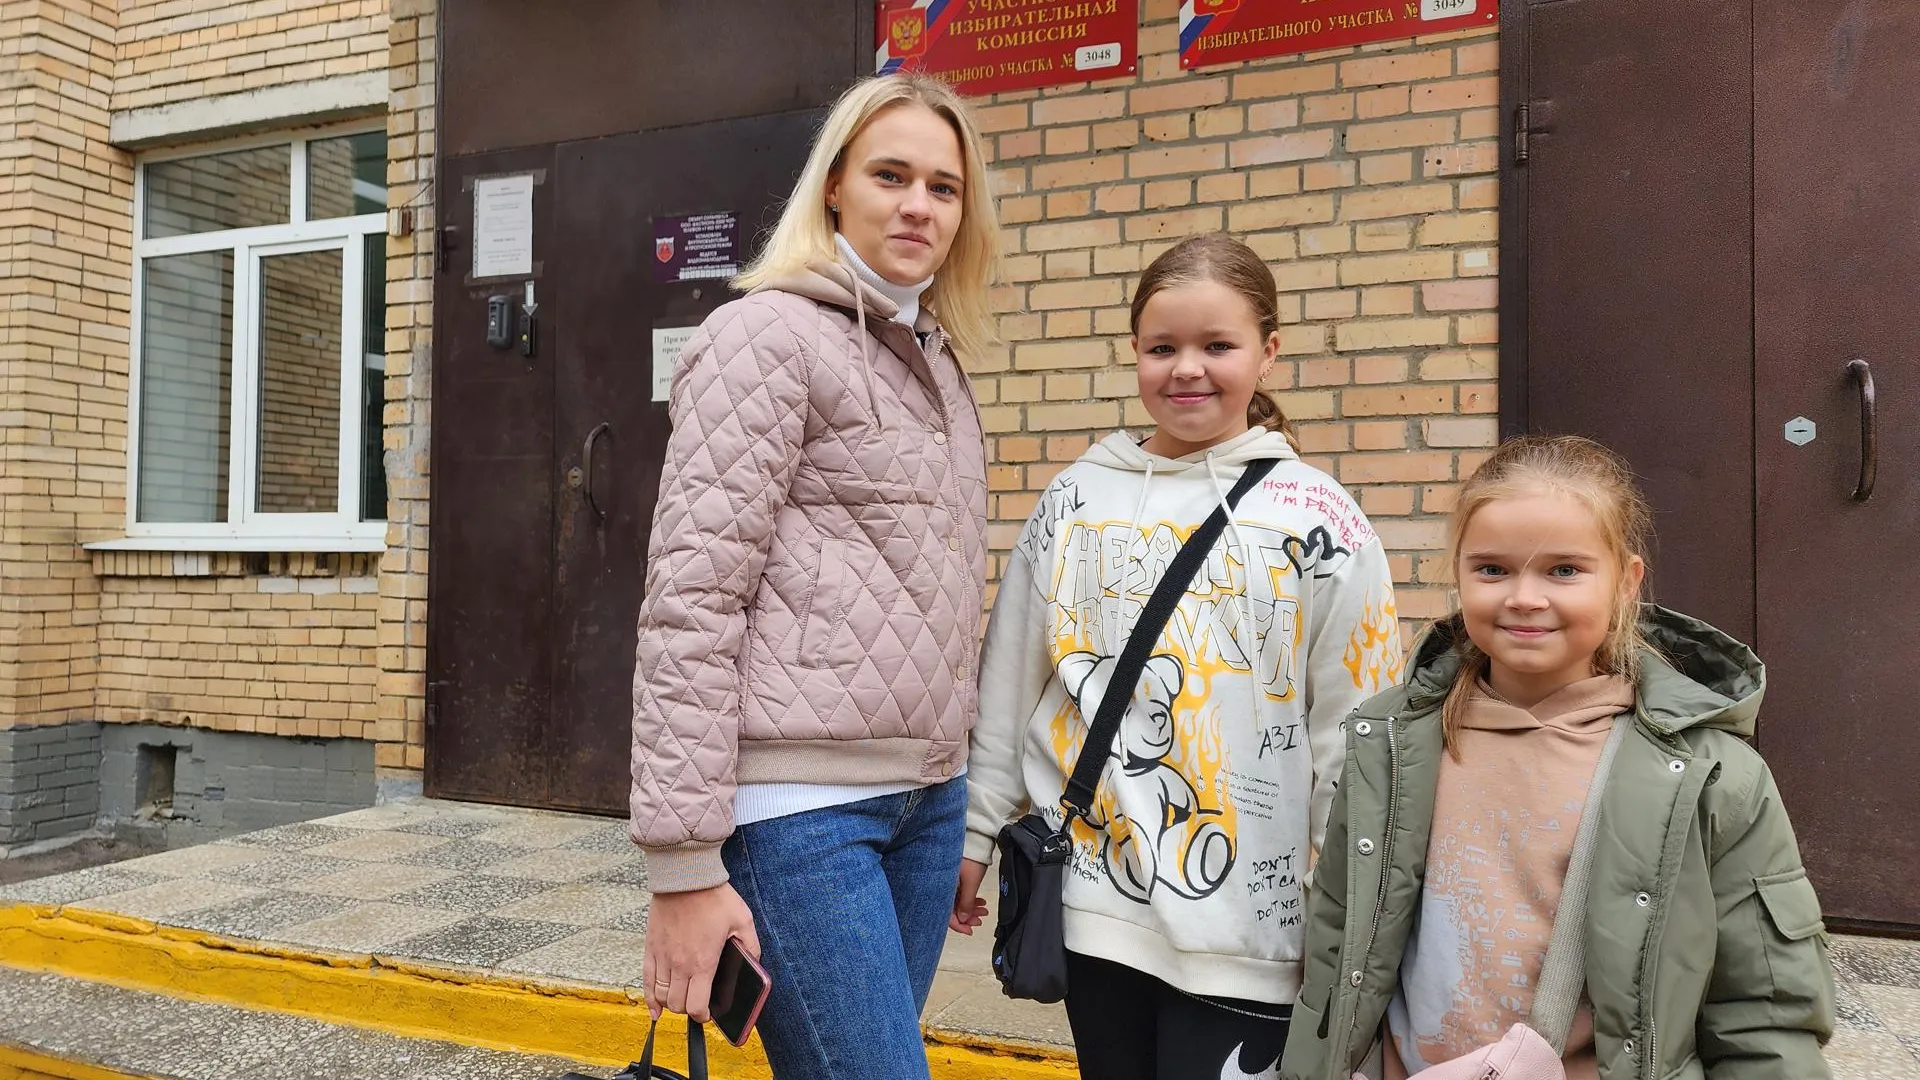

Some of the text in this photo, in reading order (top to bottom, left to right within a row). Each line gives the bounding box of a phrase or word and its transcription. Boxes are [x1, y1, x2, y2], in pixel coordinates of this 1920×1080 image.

[950, 0, 1118, 36] ИЗБИРАТЕЛЬНАЯ
[1198, 18, 1321, 50] ИЗБИРАТЕЛЬНОГО
[1328, 7, 1394, 30] УЧАСТКА
[1433, 0, 1465, 12] 3049
[976, 23, 1088, 51] КОМИССИЯ
[1000, 57, 1053, 76] УЧАСТКА
[1084, 49, 1111, 63] 3048
[1252, 853, 1292, 875] DON'T
